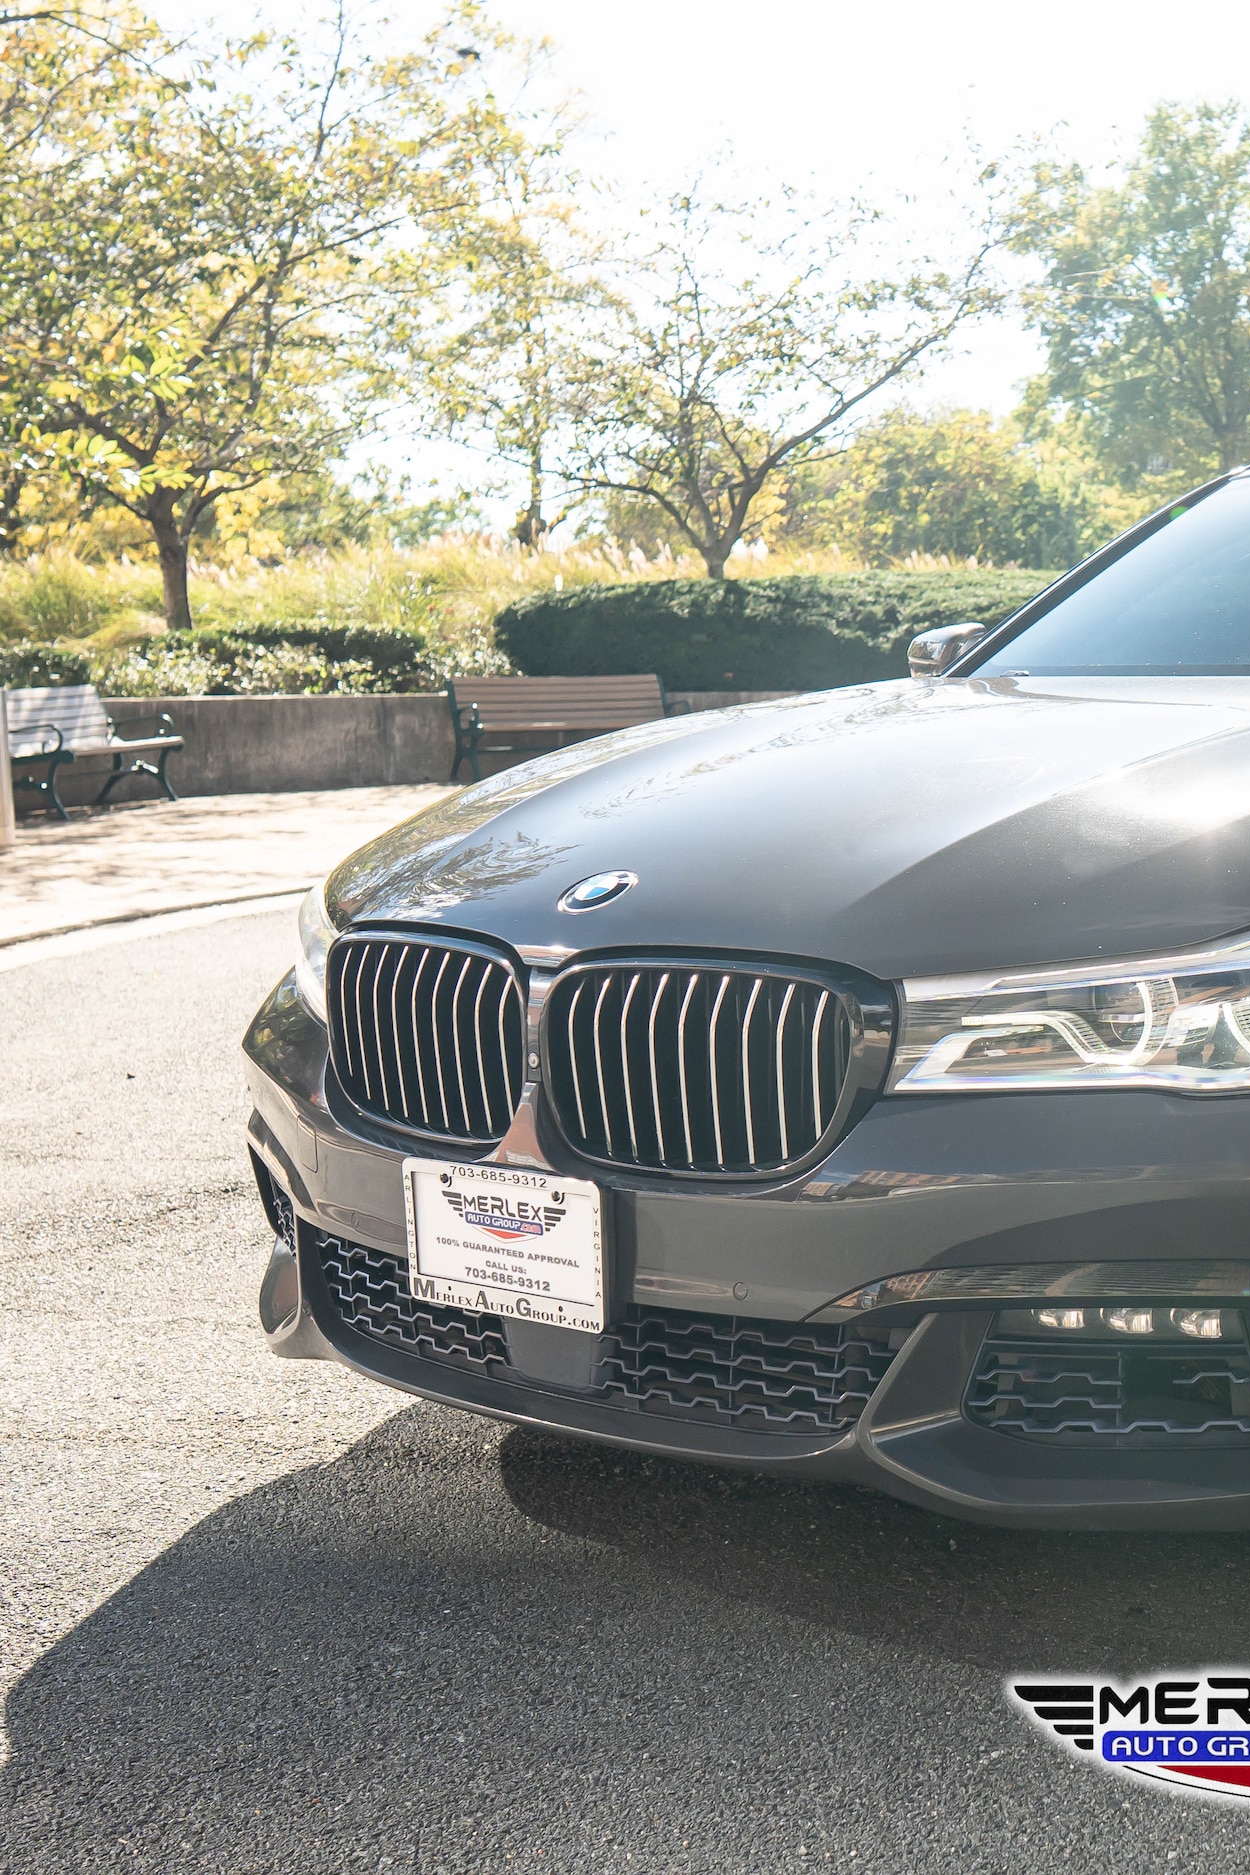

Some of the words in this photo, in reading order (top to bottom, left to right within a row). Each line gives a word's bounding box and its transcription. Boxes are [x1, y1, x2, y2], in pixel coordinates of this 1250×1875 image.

[449, 1165, 548, 1189] 703-685-9312
[463, 1194, 544, 1222] MERLEX
[467, 1213, 490, 1225] AUTO
[404, 1174, 417, 1270] ARLINGTON
[436, 1236, 460, 1248] 100%
[462, 1241, 525, 1259] GUARANTEED
[527, 1252, 580, 1268] APPROVAL
[592, 1207, 602, 1298] VIRGINIA
[464, 1266, 551, 1292] 703-685-9312
[485, 1260, 509, 1272] CALL
[511, 1264, 527, 1275] US:
